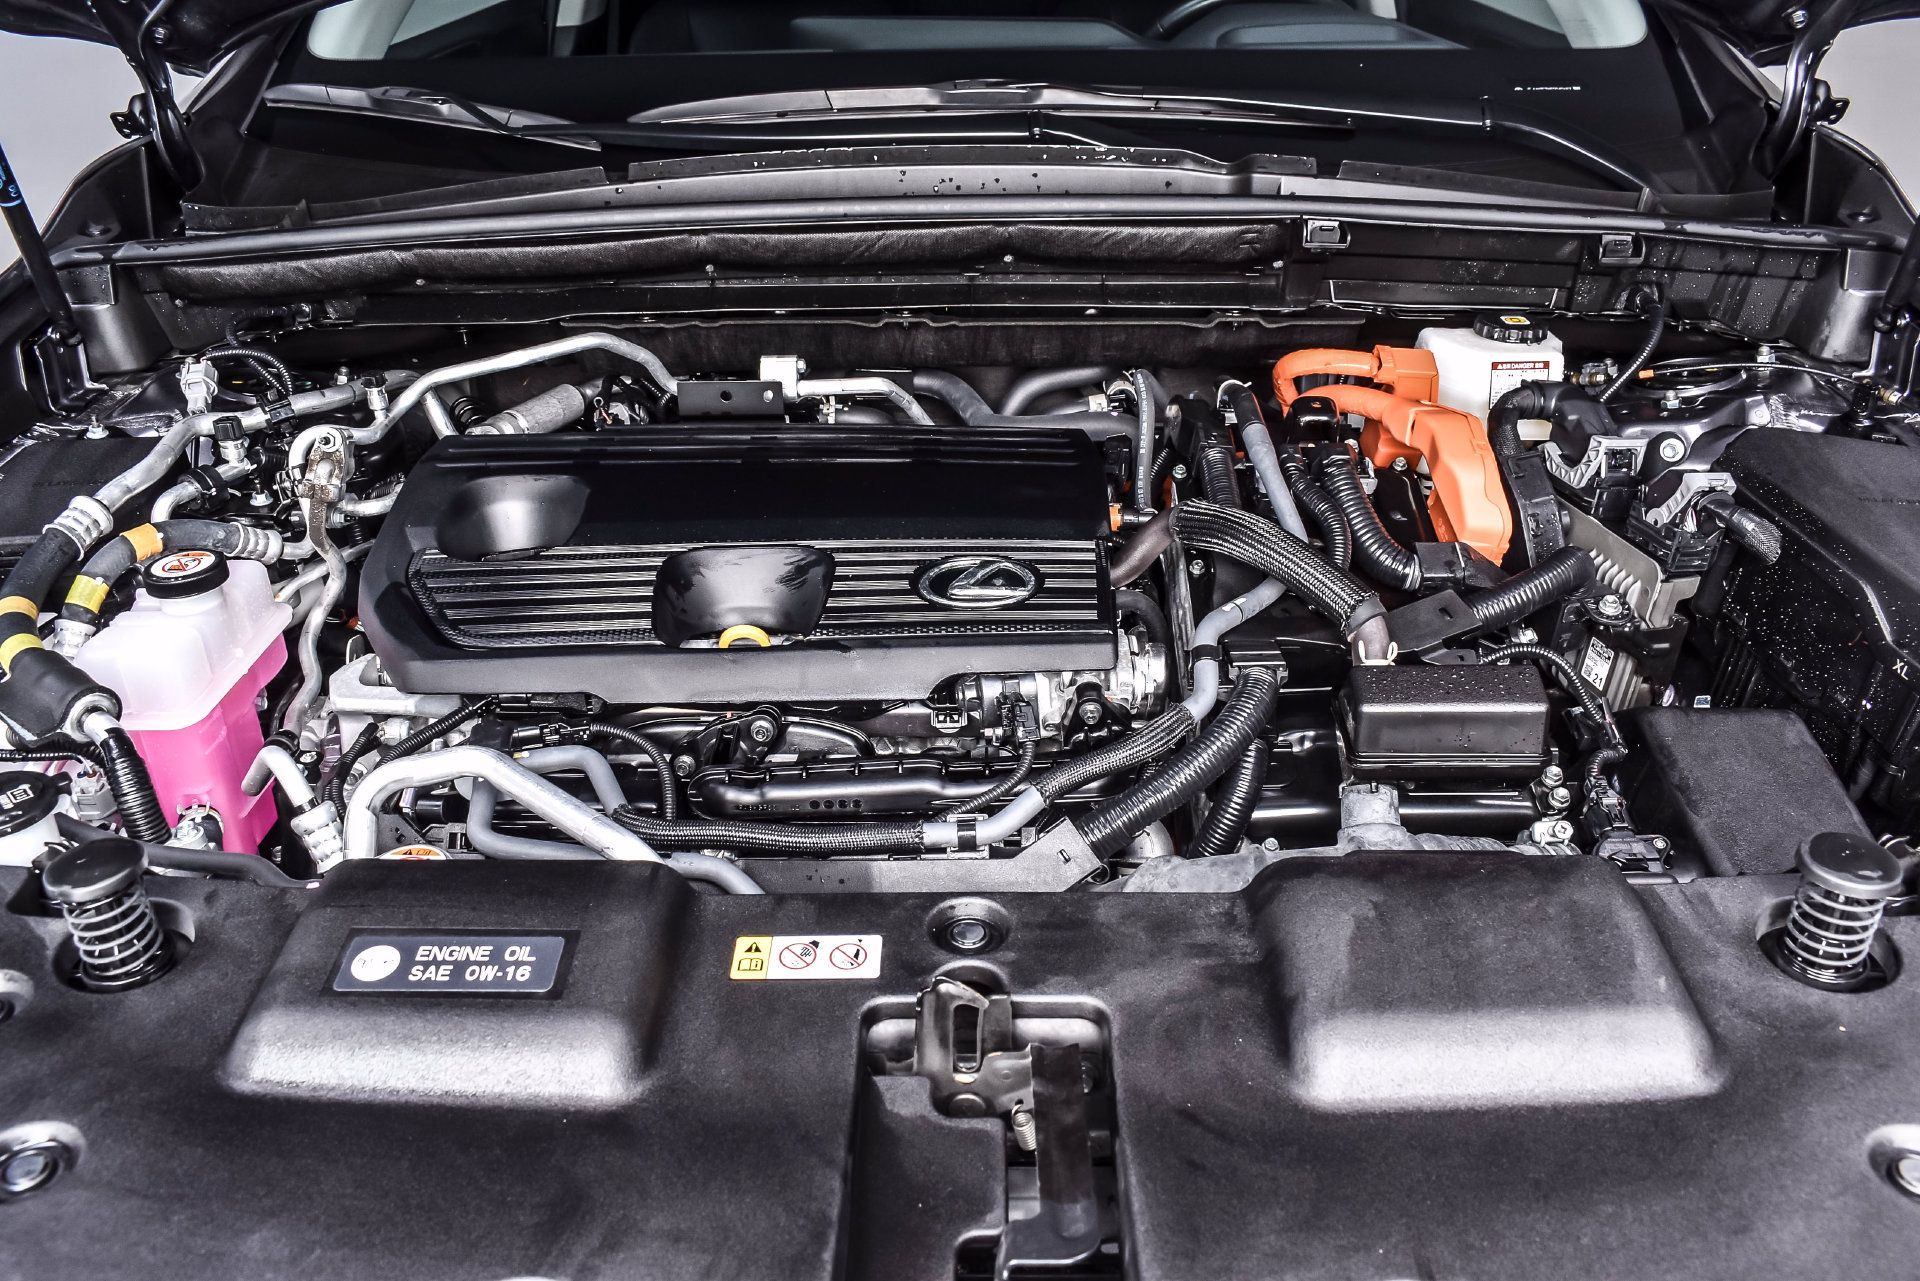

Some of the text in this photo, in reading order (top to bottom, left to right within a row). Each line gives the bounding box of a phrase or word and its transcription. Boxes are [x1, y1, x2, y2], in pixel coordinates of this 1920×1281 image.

[1511, 362, 1535, 370] DANGER
[1892, 658, 1909, 681] XL
[1592, 673, 1604, 688] 21
[414, 945, 537, 962] ENGINE OIL
[408, 965, 532, 982] SAE 0W-16
